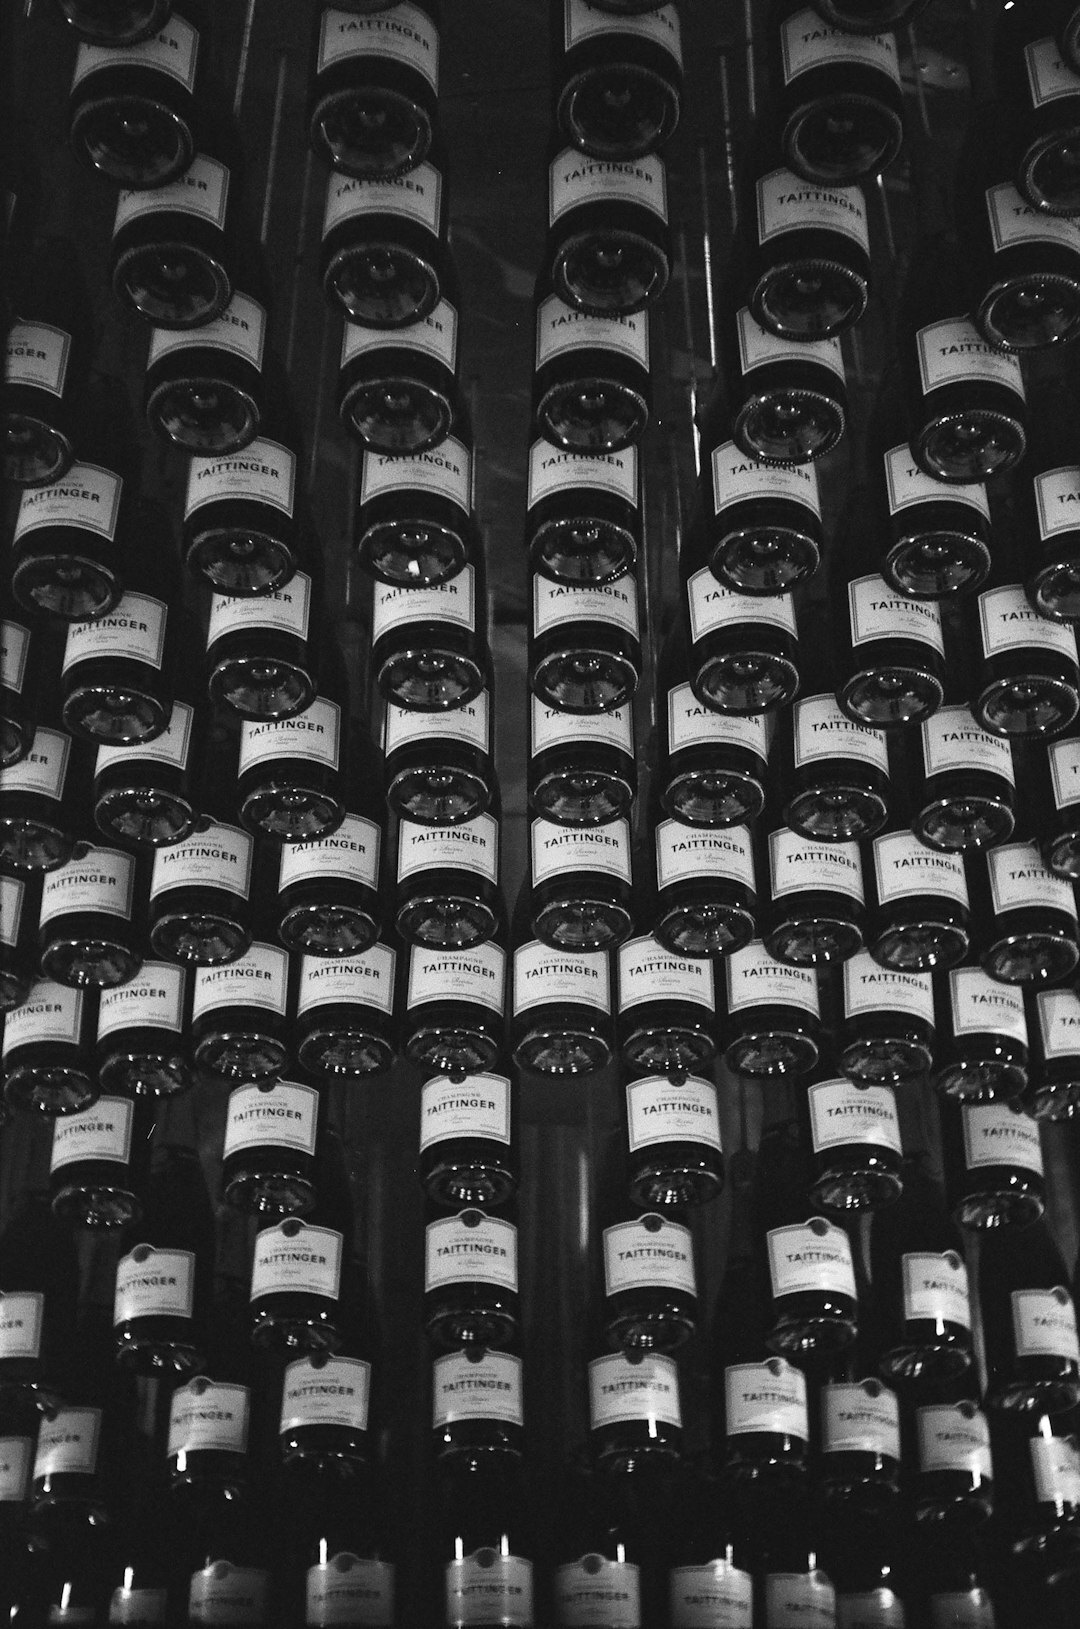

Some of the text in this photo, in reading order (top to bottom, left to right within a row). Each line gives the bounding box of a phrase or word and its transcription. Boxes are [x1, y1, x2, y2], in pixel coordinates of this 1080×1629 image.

[338, 19, 429, 51] TAITTINGER
[564, 163, 653, 184] TAITTINGER
[777, 193, 863, 218] TAITTINGER
[197, 461, 279, 479] TAITTINGER
[23, 488, 101, 509] TAITTINGER
[215, 593, 292, 613] TAITGER
[71, 617, 148, 638] TAITTINGER
[249, 721, 325, 739] TAITTINGER
[812, 722, 884, 743] TAITTINGER
[291, 839, 366, 855] TAITTINGER
[411, 832, 487, 848] TAITTINGER
[543, 833, 620, 849] TAITTINGER
[671, 840, 746, 857] TAITTINGER
[163, 849, 238, 865] TAITTINGER
[786, 853, 858, 872] TAITTINGER
[46, 876, 117, 895] TAITTINGER
[201, 968, 272, 985] TAITTINGER
[308, 965, 381, 980] TAITTINGER
[422, 964, 496, 980] TAITTINGER
[525, 966, 599, 980] TAITTINGER
[628, 962, 703, 977] TAITTINGER
[742, 966, 813, 984] TAITTINGER
[233, 1109, 303, 1122] TAITTINGER
[427, 1100, 496, 1116] TAITTINGER
[642, 1103, 713, 1116] TAITTINGER
[436, 1245, 507, 1258] TAITTINGER
[617, 1250, 688, 1262] TAITTINGER
[442, 1380, 511, 1392] TAITTINGER
